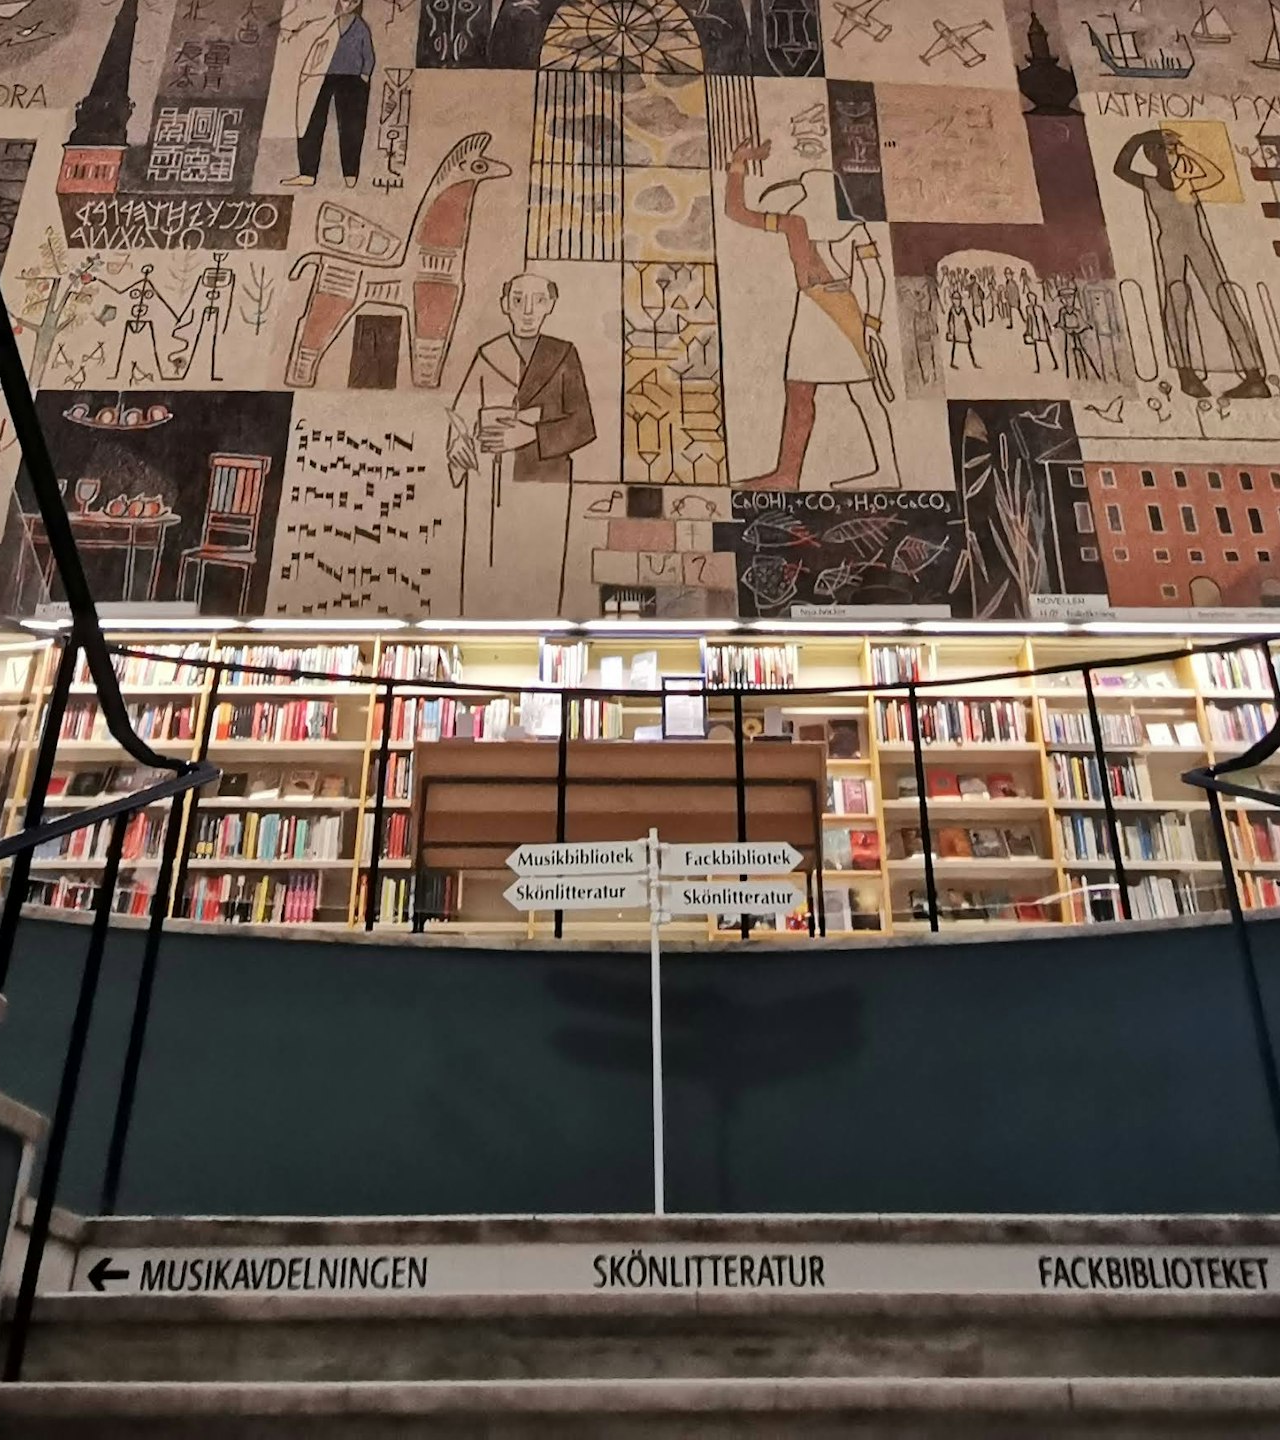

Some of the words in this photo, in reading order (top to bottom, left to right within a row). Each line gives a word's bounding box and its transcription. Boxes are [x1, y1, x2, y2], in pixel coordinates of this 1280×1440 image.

[517, 847, 634, 867] Musikbibliotek
[685, 848, 792, 867] Fackbibliotek
[516, 884, 627, 902] Skönlitteratur
[683, 887, 794, 906] Skönlitteratur
[139, 1255, 428, 1292] MUSIKAVDELNINGEN
[593, 1248, 826, 1288] SKÖNLITTERATUR
[1038, 1255, 1269, 1289] FACKBIBLIOTEKET
